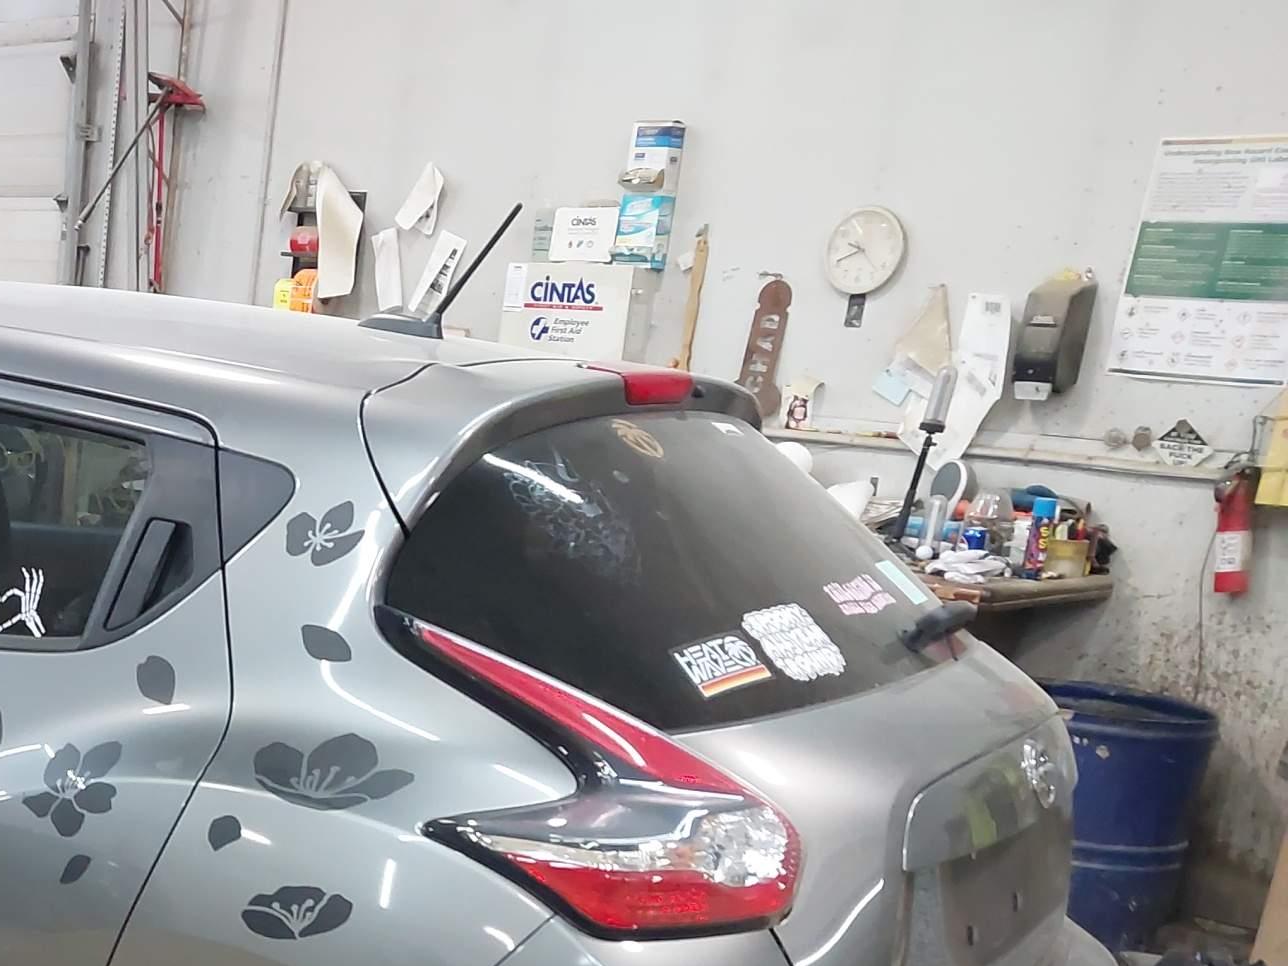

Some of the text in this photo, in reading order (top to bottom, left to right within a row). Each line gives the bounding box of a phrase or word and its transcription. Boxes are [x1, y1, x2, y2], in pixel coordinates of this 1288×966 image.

[530, 275, 596, 304] CINTAS
[553, 318, 590, 328] Employee
[568, 327, 583, 335] Aid
[674, 638, 730, 668] HEAT
